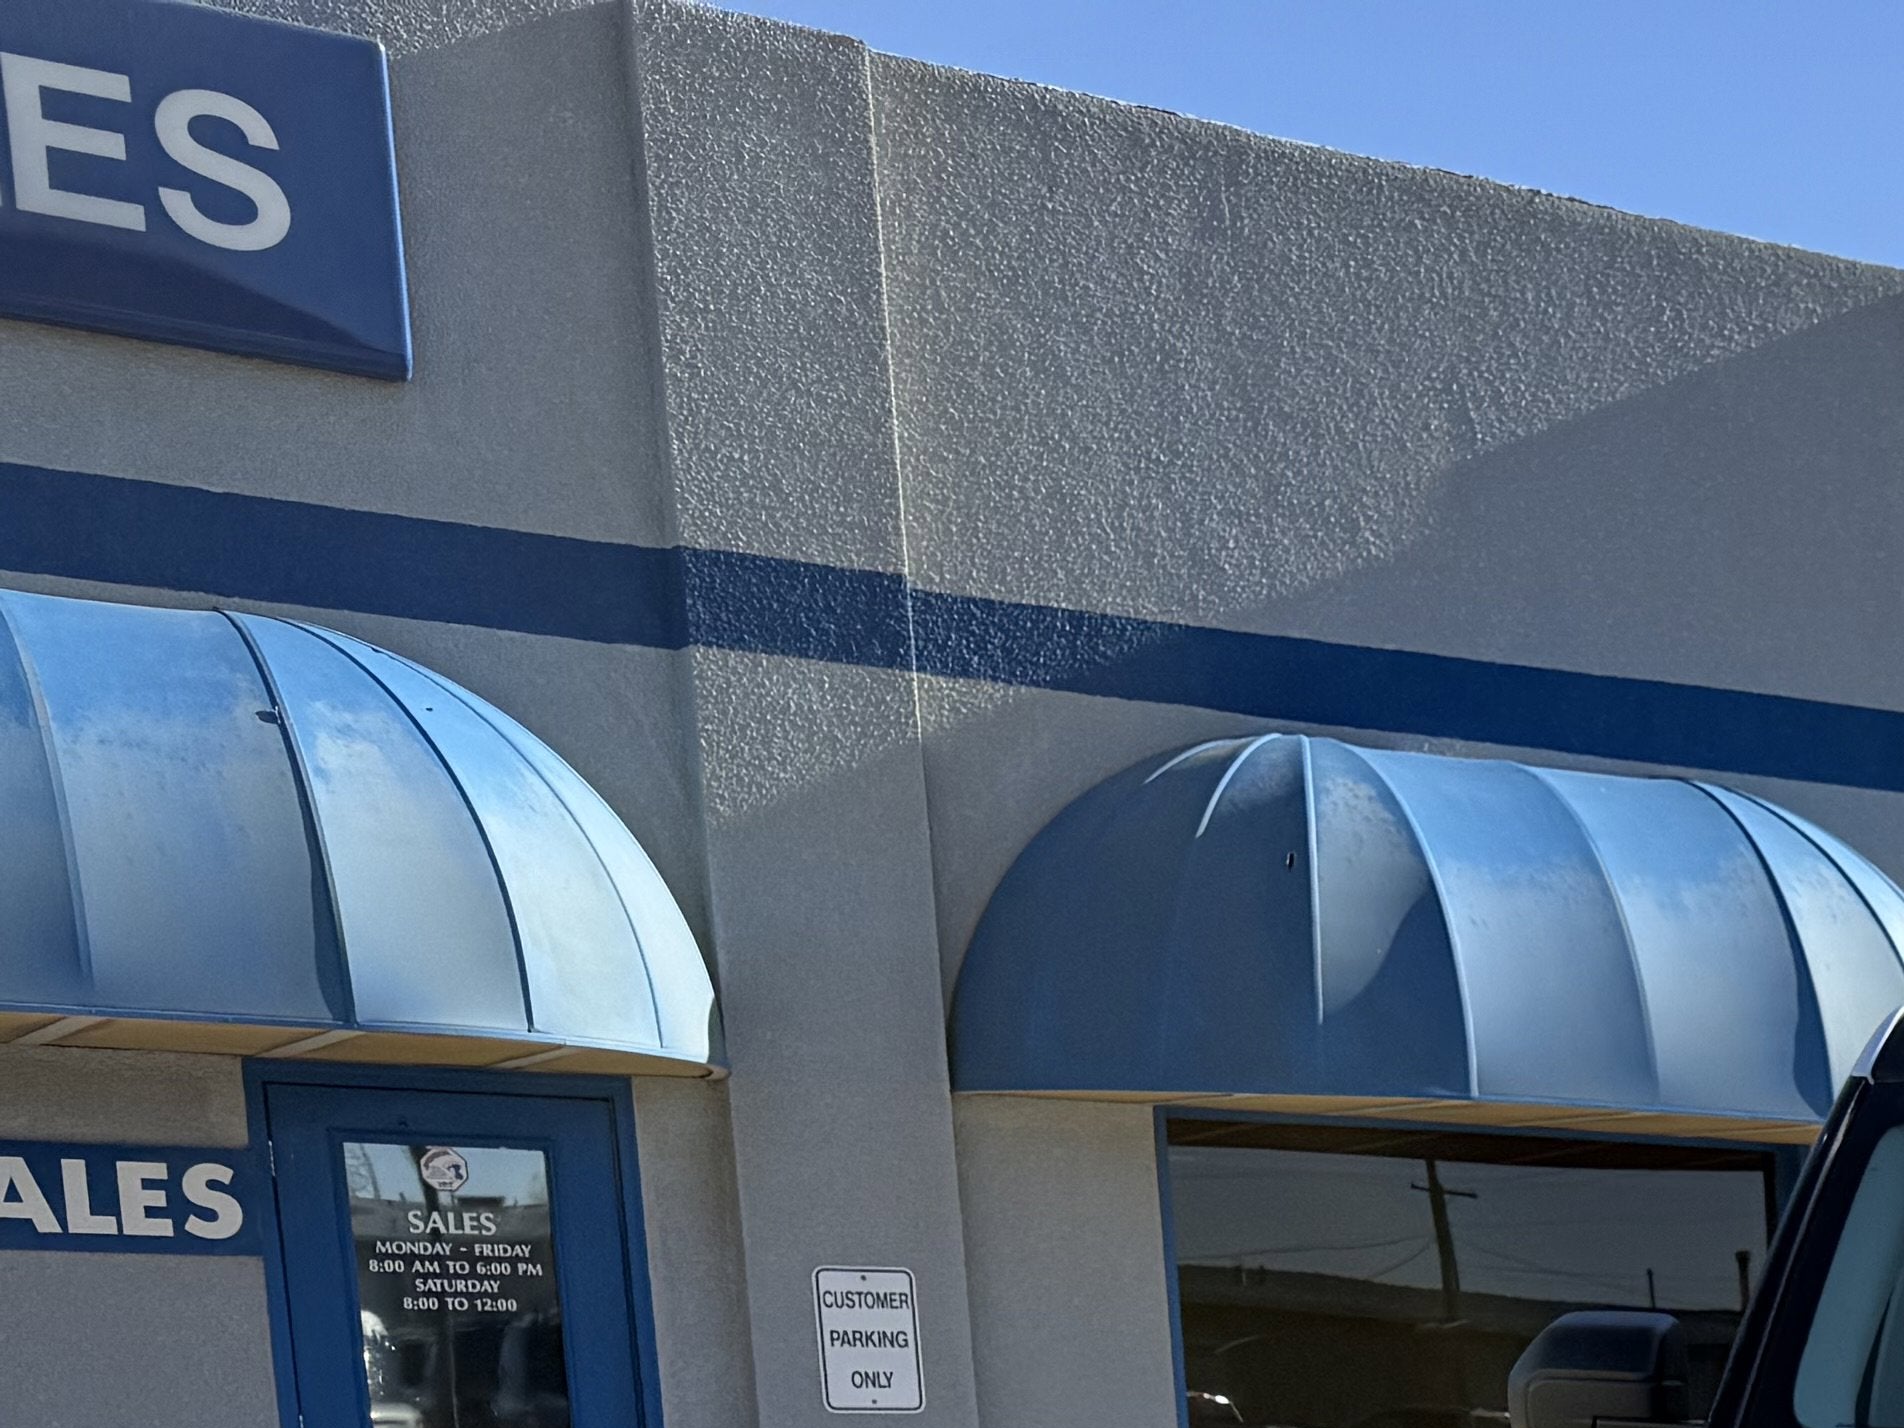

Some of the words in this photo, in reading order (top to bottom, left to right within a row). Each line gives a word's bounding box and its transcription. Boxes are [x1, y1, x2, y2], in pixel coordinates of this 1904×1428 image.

[407, 1210, 497, 1236] SALES
[375, 1240, 452, 1256] MONDAY
[474, 1244, 532, 1258] FRIDAY
[369, 1259, 405, 1273] 8:00
[412, 1260, 440, 1274] AM
[446, 1261, 470, 1275] TO
[476, 1262, 511, 1276] 6:00
[517, 1263, 543, 1277] PM
[415, 1278, 500, 1293] SATURDAY
[403, 1297, 439, 1311] 8:00
[445, 1297, 468, 1312] TO
[476, 1298, 518, 1312] 12:00
[822, 1290, 909, 1310] CUSTOMER
[830, 1329, 909, 1348] PARKING
[851, 1371, 893, 1389] ONLY
